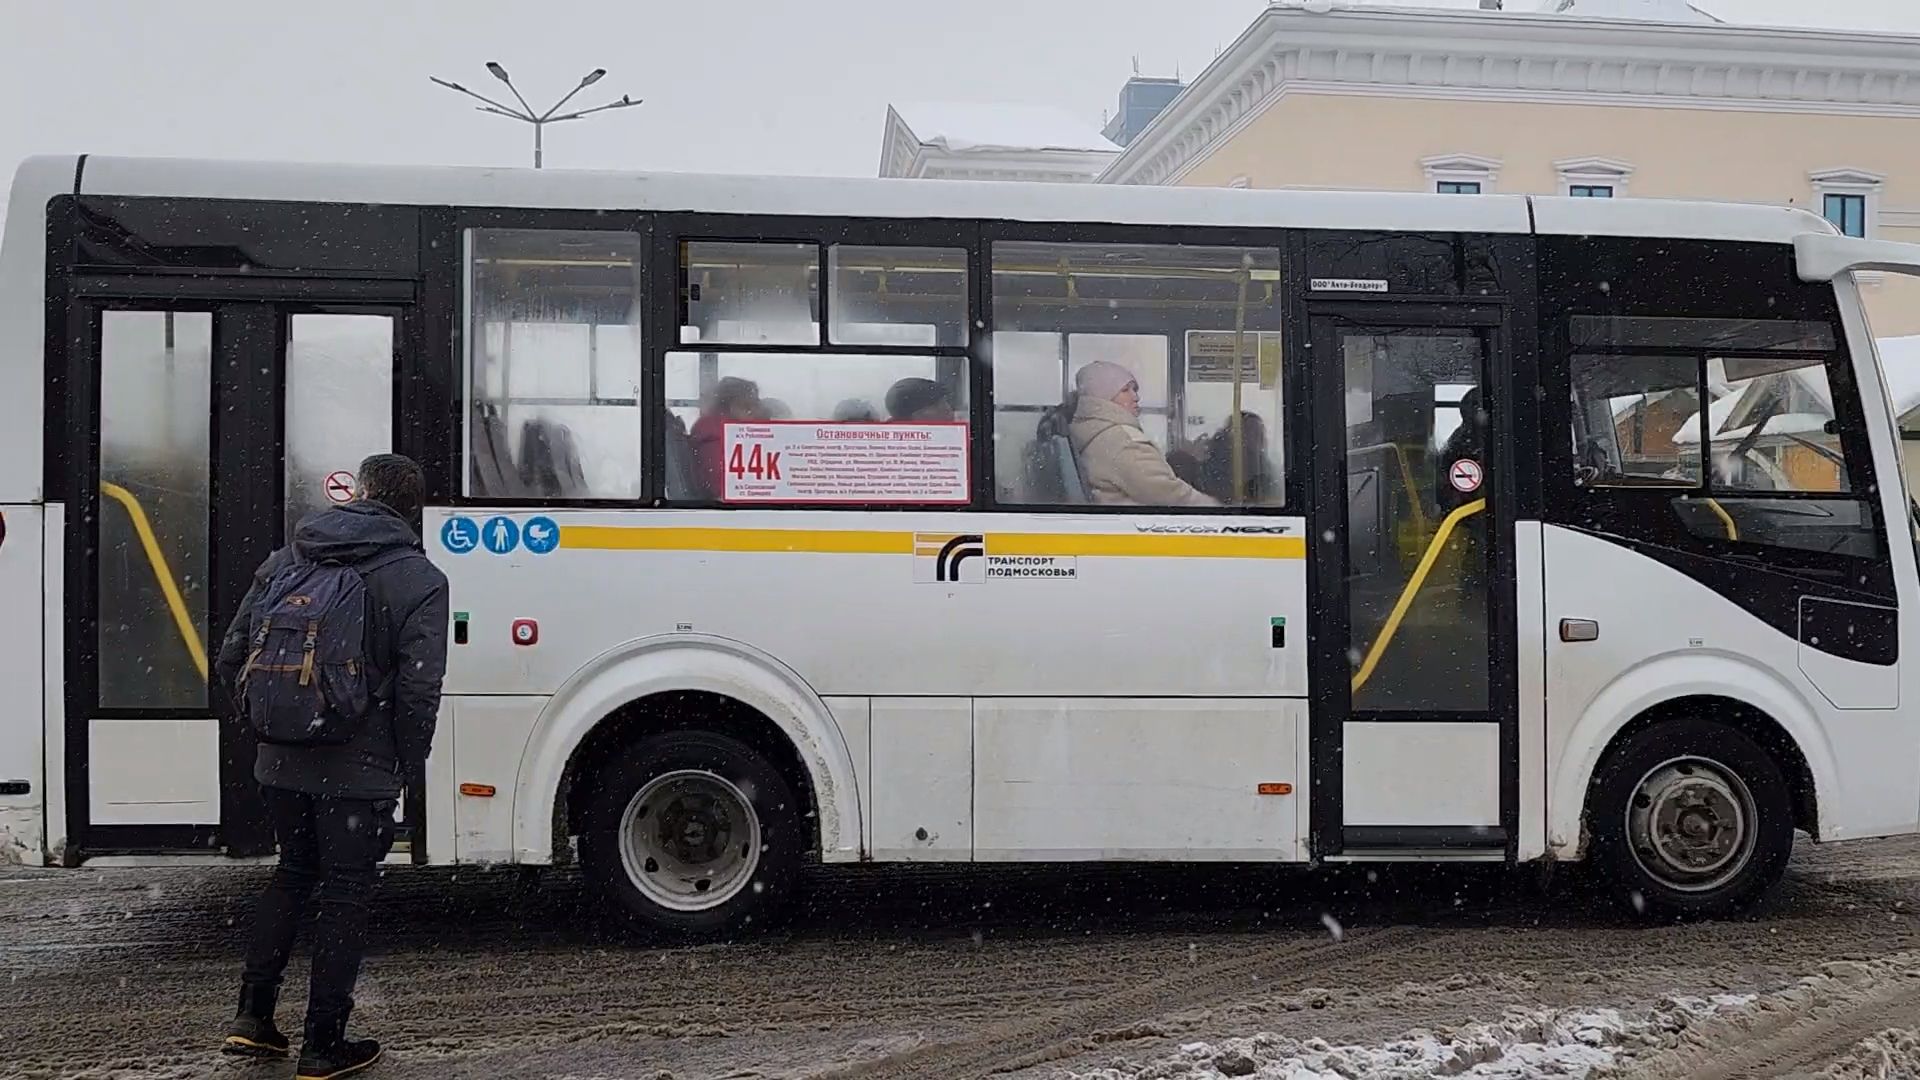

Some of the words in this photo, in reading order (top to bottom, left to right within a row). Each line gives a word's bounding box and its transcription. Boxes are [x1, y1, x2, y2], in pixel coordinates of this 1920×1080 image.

[816, 428, 890, 440] Остановочные
[893, 430, 932, 441] пункты:
[1134, 523, 1219, 533] VECTOR
[1221, 525, 1291, 534] NEXT
[987, 557, 1055, 566] ТРАНСПОРТ
[987, 568, 1075, 577] ПОДМОСКОВЬЯ
